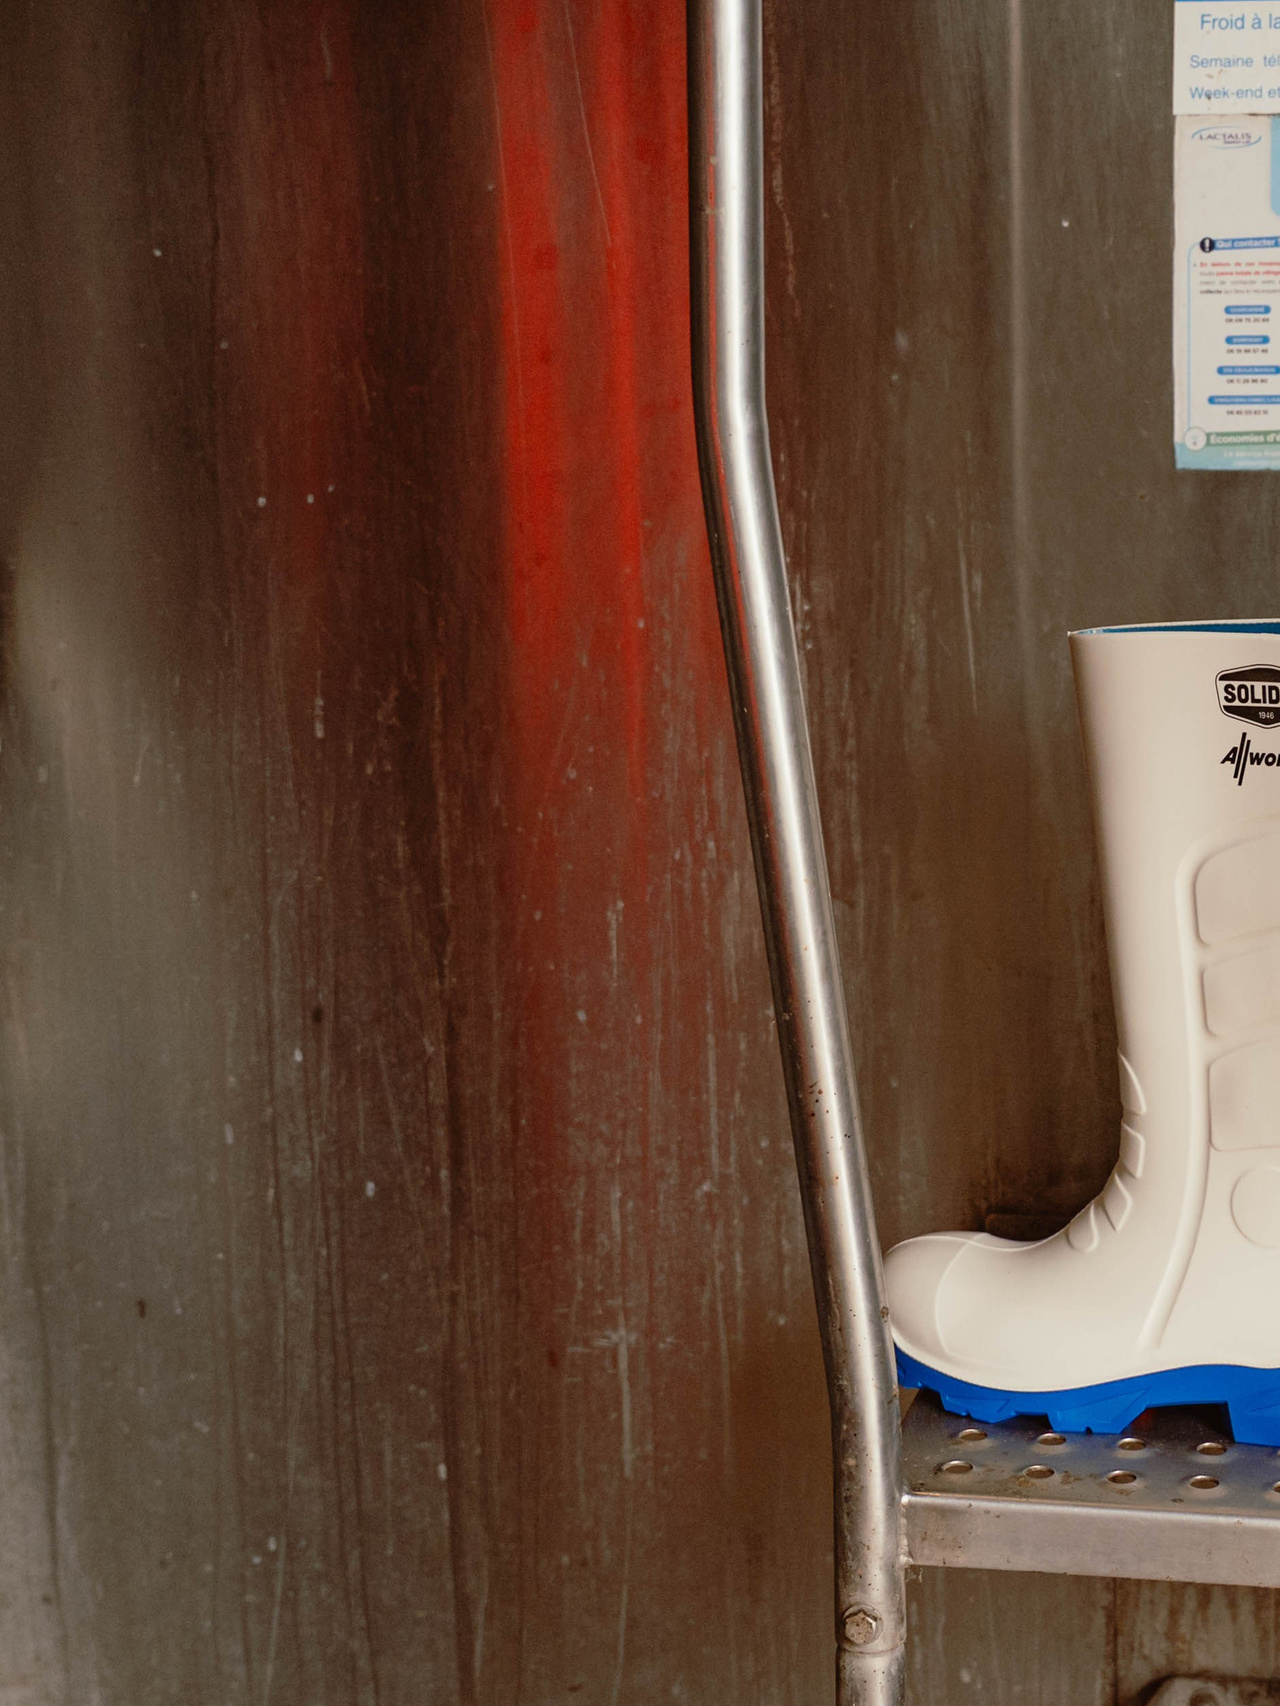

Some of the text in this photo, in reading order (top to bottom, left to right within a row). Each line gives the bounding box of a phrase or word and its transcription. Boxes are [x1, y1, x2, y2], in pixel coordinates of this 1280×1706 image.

[1200, 14, 1246, 30] Froid
[1251, 13, 1262, 30] à
[1190, 54, 1254, 68] Semaine
[1264, 54, 1280, 68] tél
[1190, 85, 1264, 100] Week-end
[1268, 86, 1280, 98] et
[1200, 132, 1252, 140] LACTALIS
[1216, 240, 1232, 249] Qui
[1234, 238, 1276, 248] contacter
[1210, 432, 1264, 445] Économies
[1258, 712, 1274, 720] 1946
